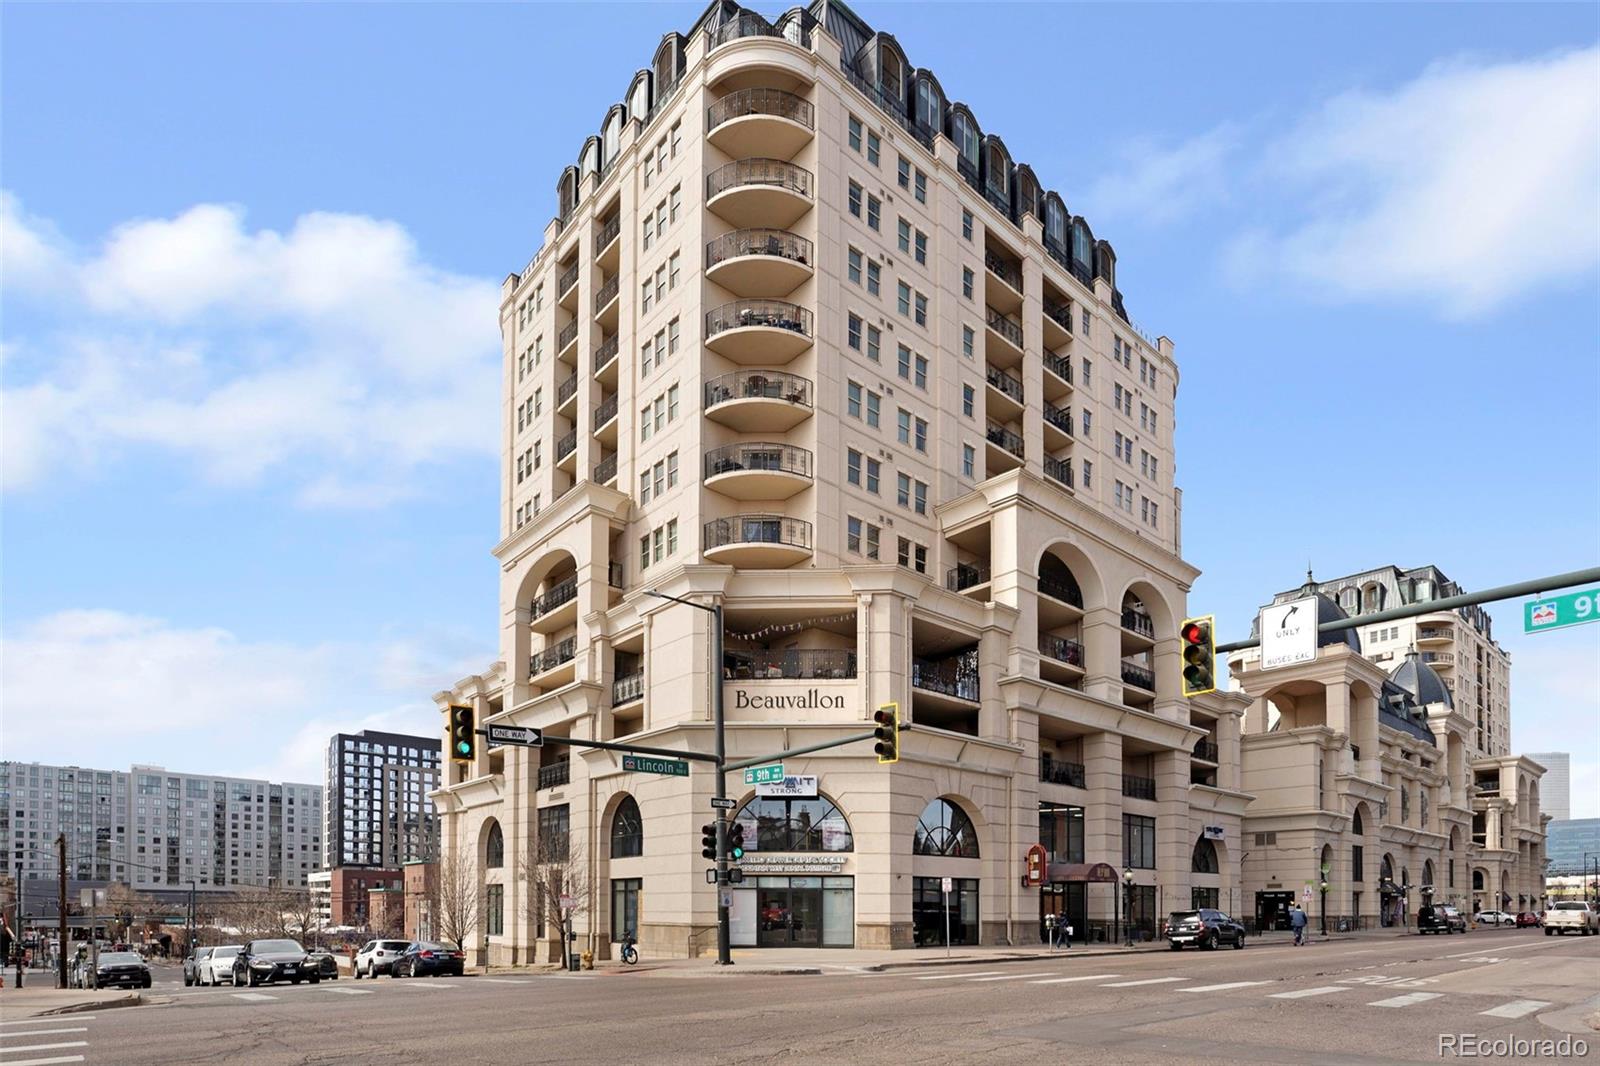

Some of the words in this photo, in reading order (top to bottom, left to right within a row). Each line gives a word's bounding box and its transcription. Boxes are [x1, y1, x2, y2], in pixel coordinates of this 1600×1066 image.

[1275, 626, 1300, 638] ONLY
[735, 688, 845, 709] Beauvallon
[494, 729, 509, 737] ONE
[637, 759, 674, 773] Lincoln
[756, 769, 770, 781] 9th
